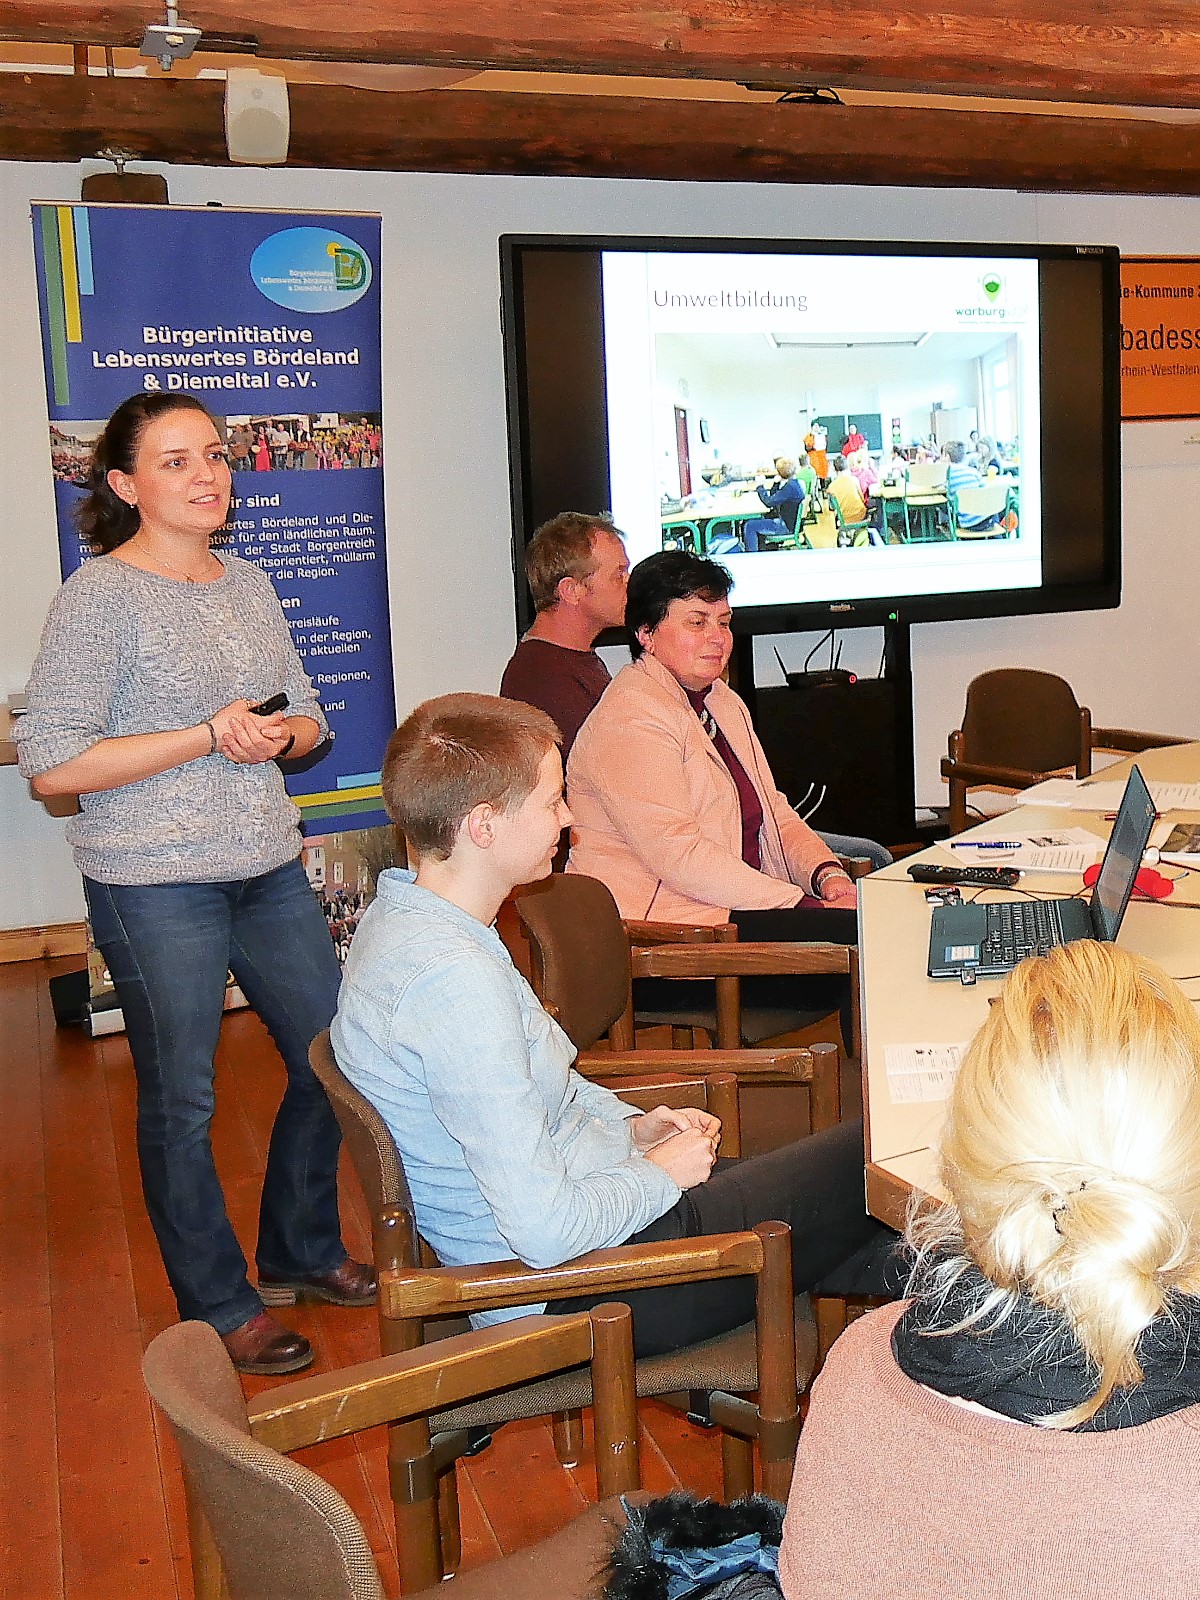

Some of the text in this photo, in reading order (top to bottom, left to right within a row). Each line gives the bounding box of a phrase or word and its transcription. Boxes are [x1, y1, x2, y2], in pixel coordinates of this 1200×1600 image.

[653, 289, 809, 312] Umweltbildung
[955, 307, 1005, 318] warburg
[143, 326, 313, 347] Bürgerinitiative
[92, 348, 359, 368] Lebenswertes Bördeland
[1121, 363, 1200, 377] rhein-Westfalen
[143, 371, 318, 391] & Diemeltal e.V.
[246, 493, 280, 508] sind
[261, 515, 319, 528] Bördeland
[325, 513, 346, 525] und
[352, 512, 374, 523] Die-
[238, 531, 254, 543] für
[258, 530, 280, 541] den
[283, 527, 340, 540] ländlichen
[343, 526, 376, 537] Raum.
[244, 544, 265, 556] der
[270, 542, 301, 554] Stadt
[307, 538, 375, 553] Borgentreich
[332, 550, 376, 563] müllarm
[276, 569, 294, 580] die
[297, 567, 338, 581] Region.
[296, 628, 372, 644] in der Region,
[310, 642, 361, 657] aktuellen
[317, 669, 371, 685] Regionen,
[324, 699, 346, 712] und
